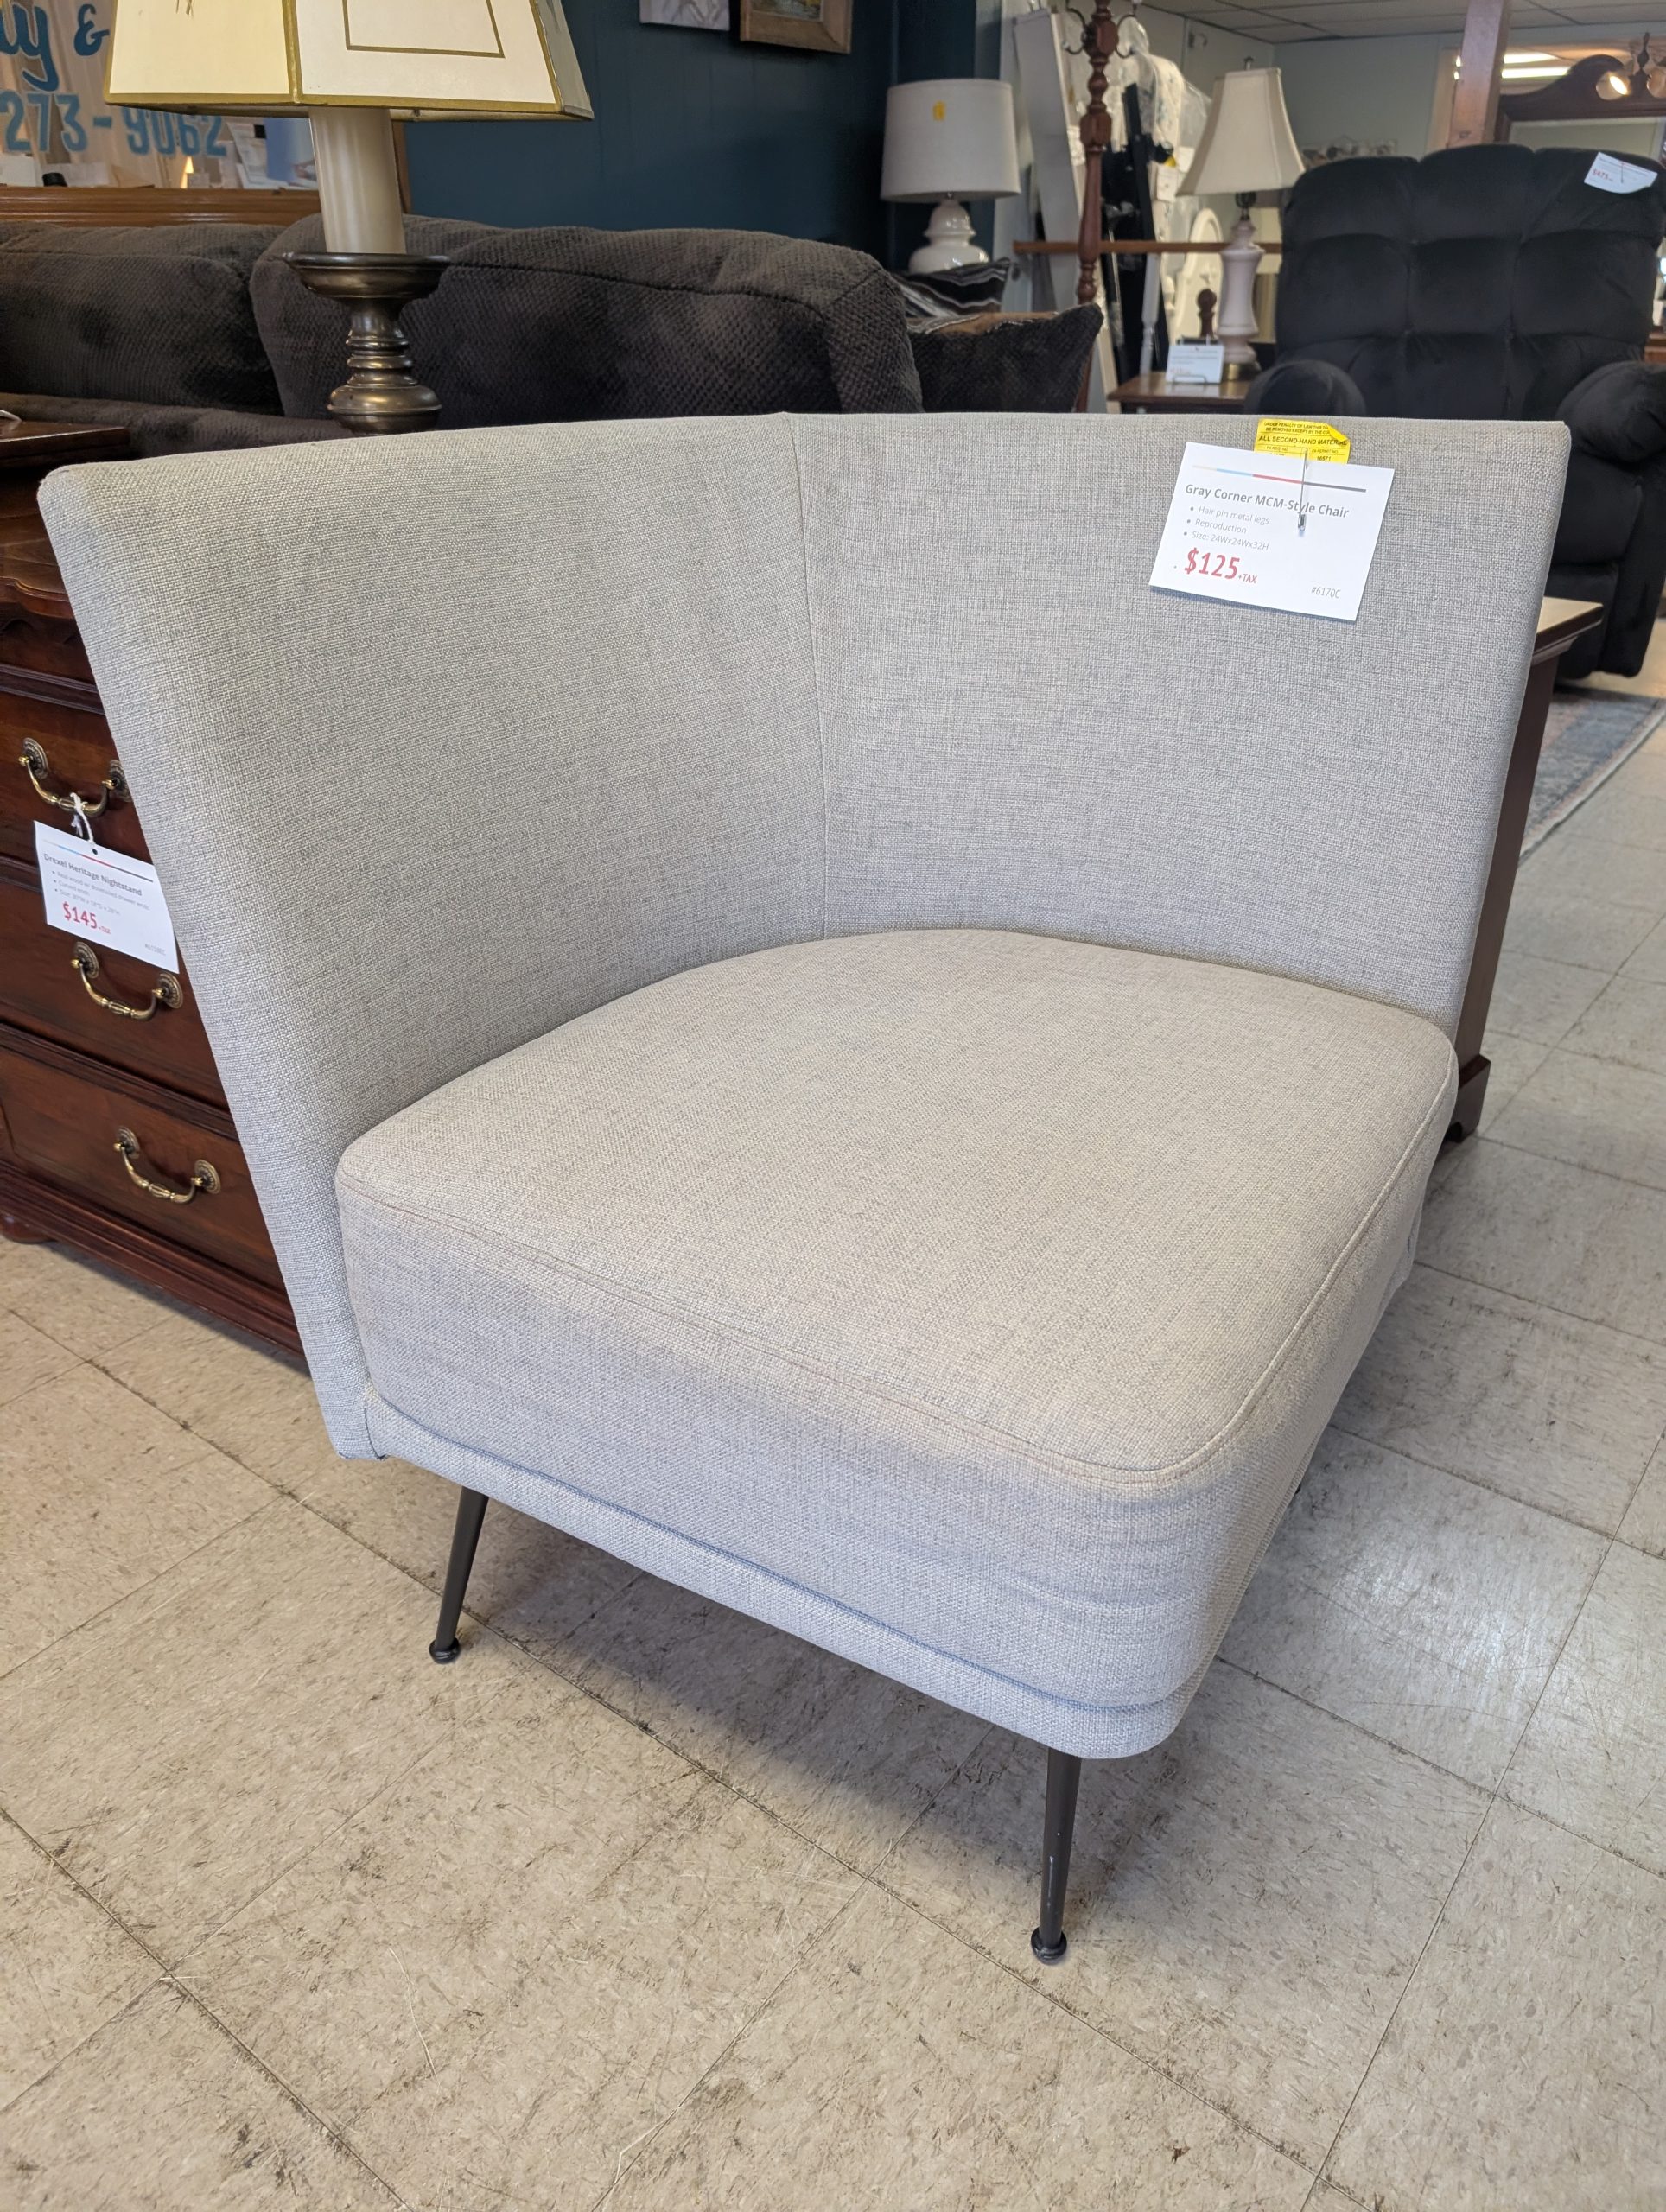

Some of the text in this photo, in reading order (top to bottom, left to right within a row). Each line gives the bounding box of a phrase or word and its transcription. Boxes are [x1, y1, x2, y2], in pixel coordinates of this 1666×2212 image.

[73, 3, 111, 56] &
[1272, 435, 1317, 445] SECOND-HAND
[1186, 484, 1349, 518] Gray Corner MCM-Style Chair
[1195, 518, 1247, 534] Reproduction
[1199, 505, 1270, 526] Hair pin metal legs
[1191, 531, 1269, 551] Size: 24Wx24Wx32H
[1184, 547, 1258, 584] $125 +TAX
[1311, 586, 1341, 599] #6170C
[44, 853, 67, 868] Drexel
[68, 863, 99, 881] Heritage
[101, 874, 142, 896] Nightstand
[62, 901, 98, 930] $145
